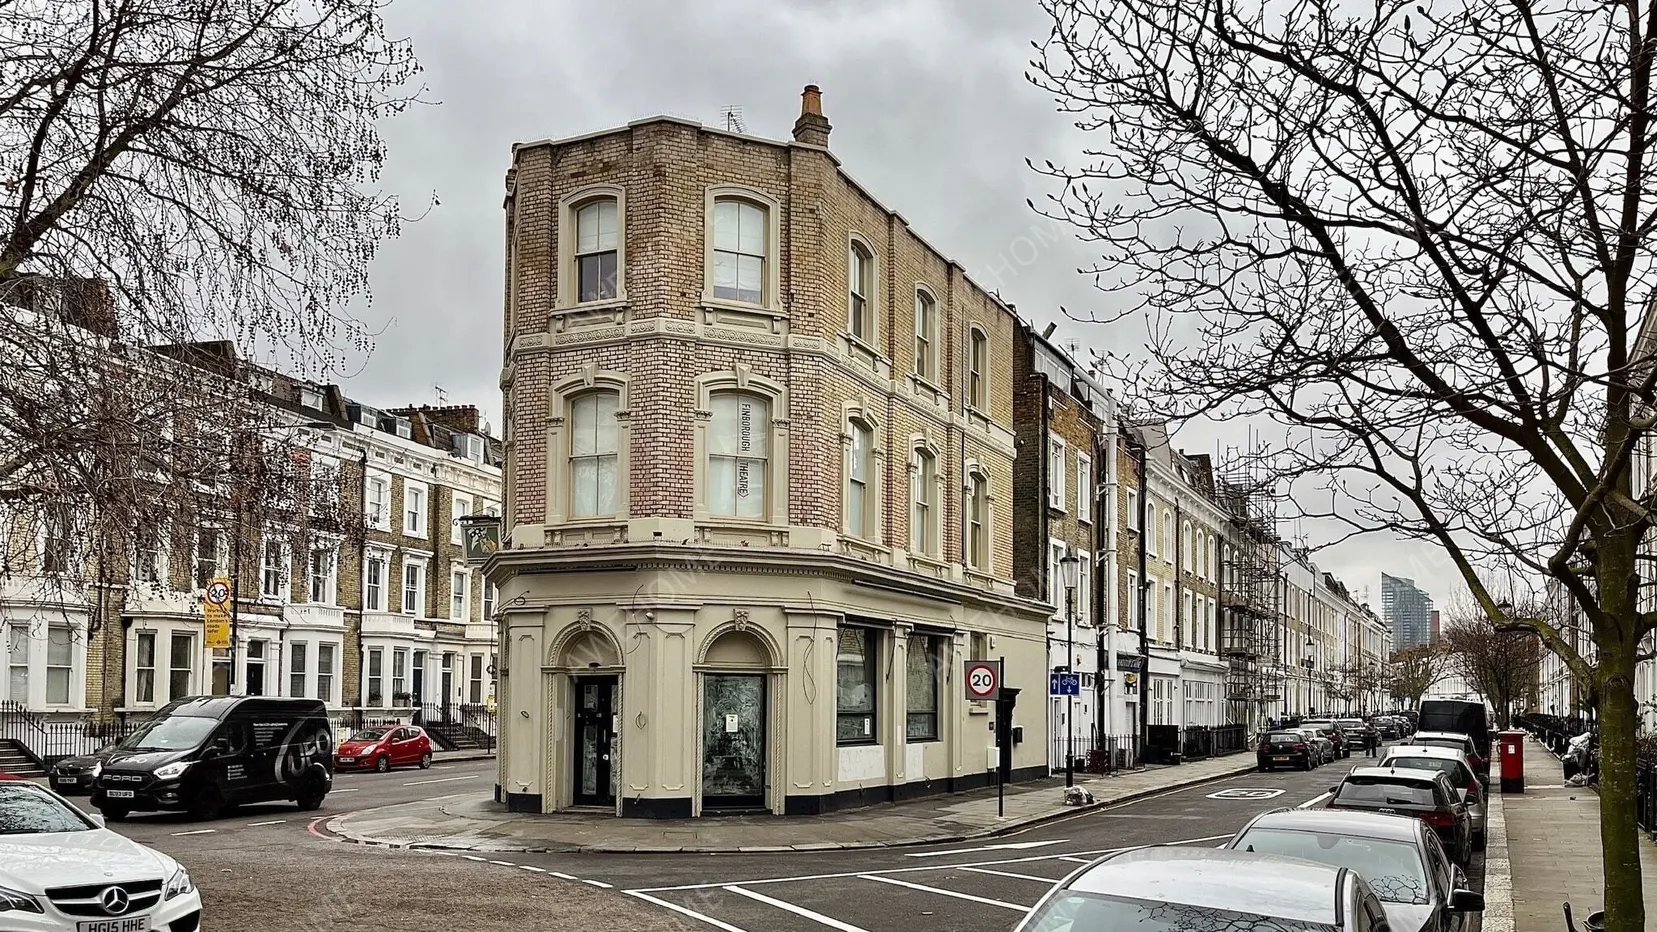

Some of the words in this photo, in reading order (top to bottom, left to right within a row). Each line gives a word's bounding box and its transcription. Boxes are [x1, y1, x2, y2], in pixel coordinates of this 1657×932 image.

[741, 403, 751, 452] FINBOROUGH
[738, 462, 749, 495] THEATRE
[211, 588, 226, 597] 20
[972, 674, 992, 687] 20
[102, 774, 142, 782] FORD
[122, 918, 145, 932] HHE
